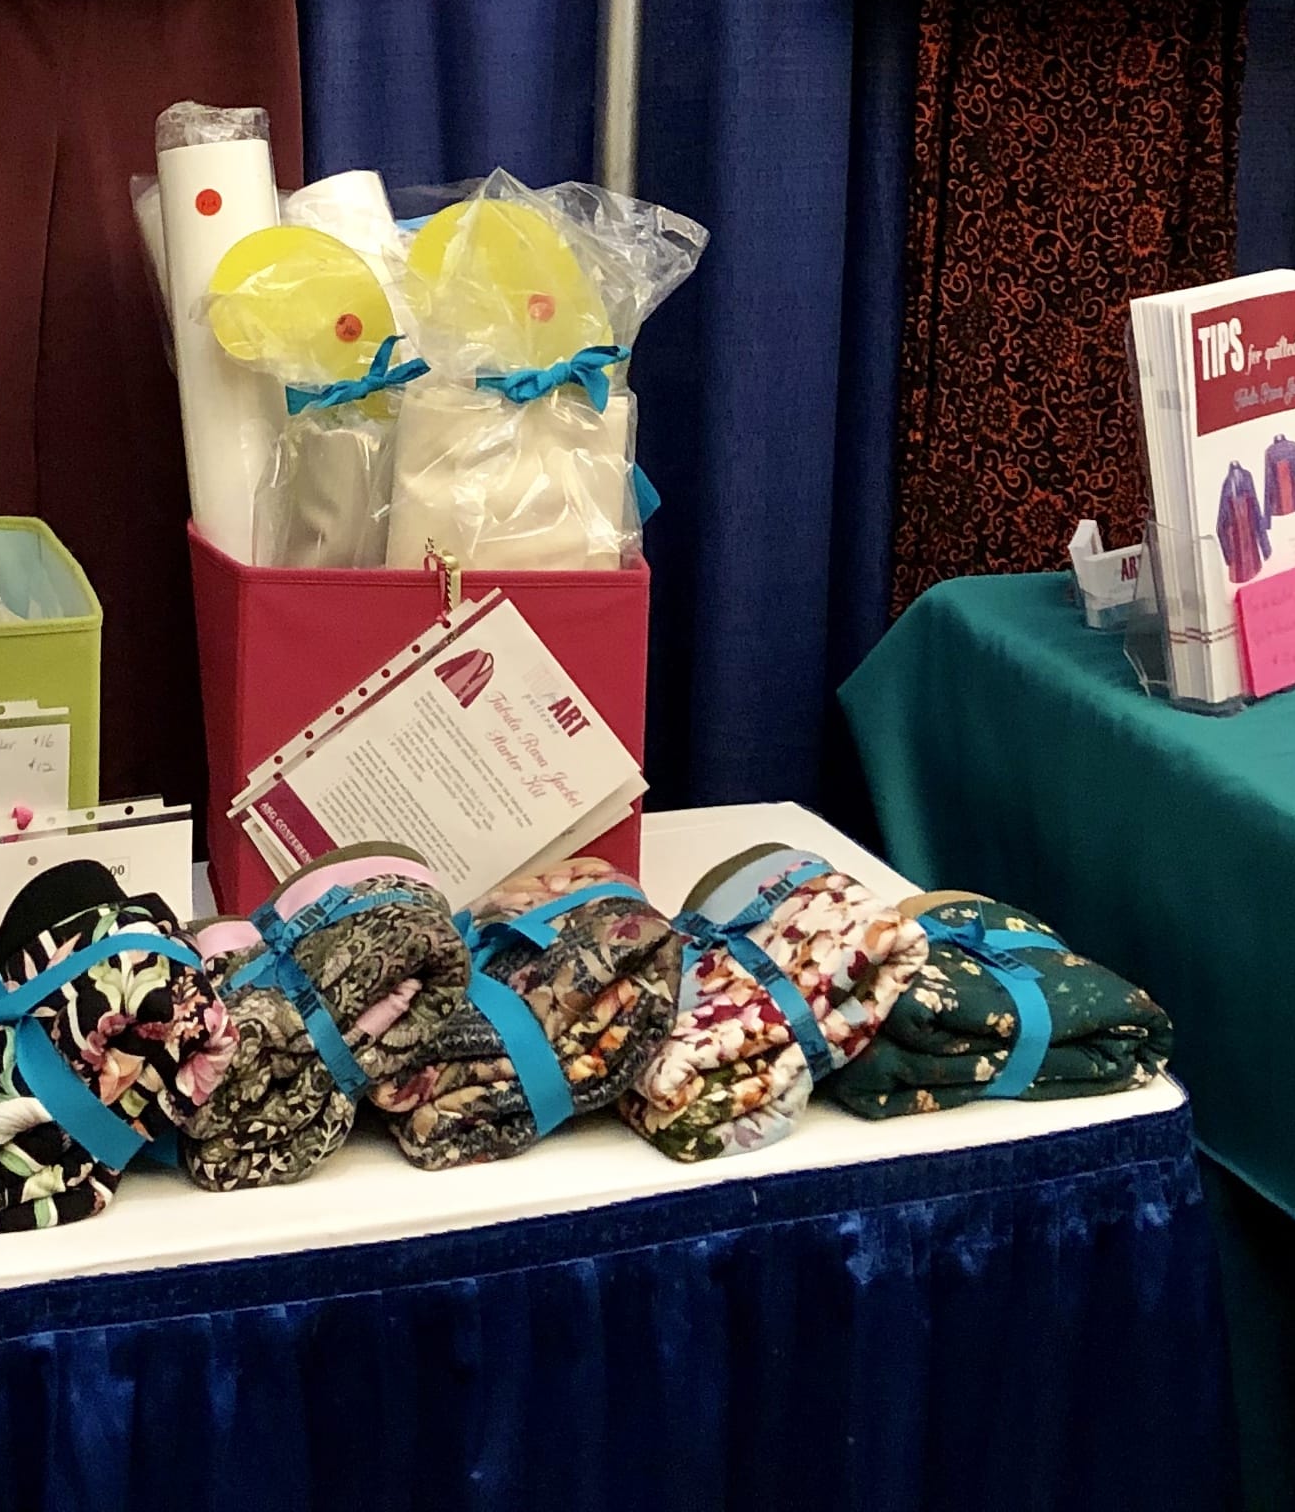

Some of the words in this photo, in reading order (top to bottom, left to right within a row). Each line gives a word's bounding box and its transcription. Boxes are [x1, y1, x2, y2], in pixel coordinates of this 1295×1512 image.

[1198, 318, 1245, 381] TIPS
[1245, 344, 1262, 376] for
[486, 691, 522, 732] Tabula
[519, 733, 548, 768] Rasa
[541, 771, 584, 808] Jacket
[548, 696, 591, 738] ART
[485, 729, 522, 772] Starter
[521, 774, 547, 798] Kit
